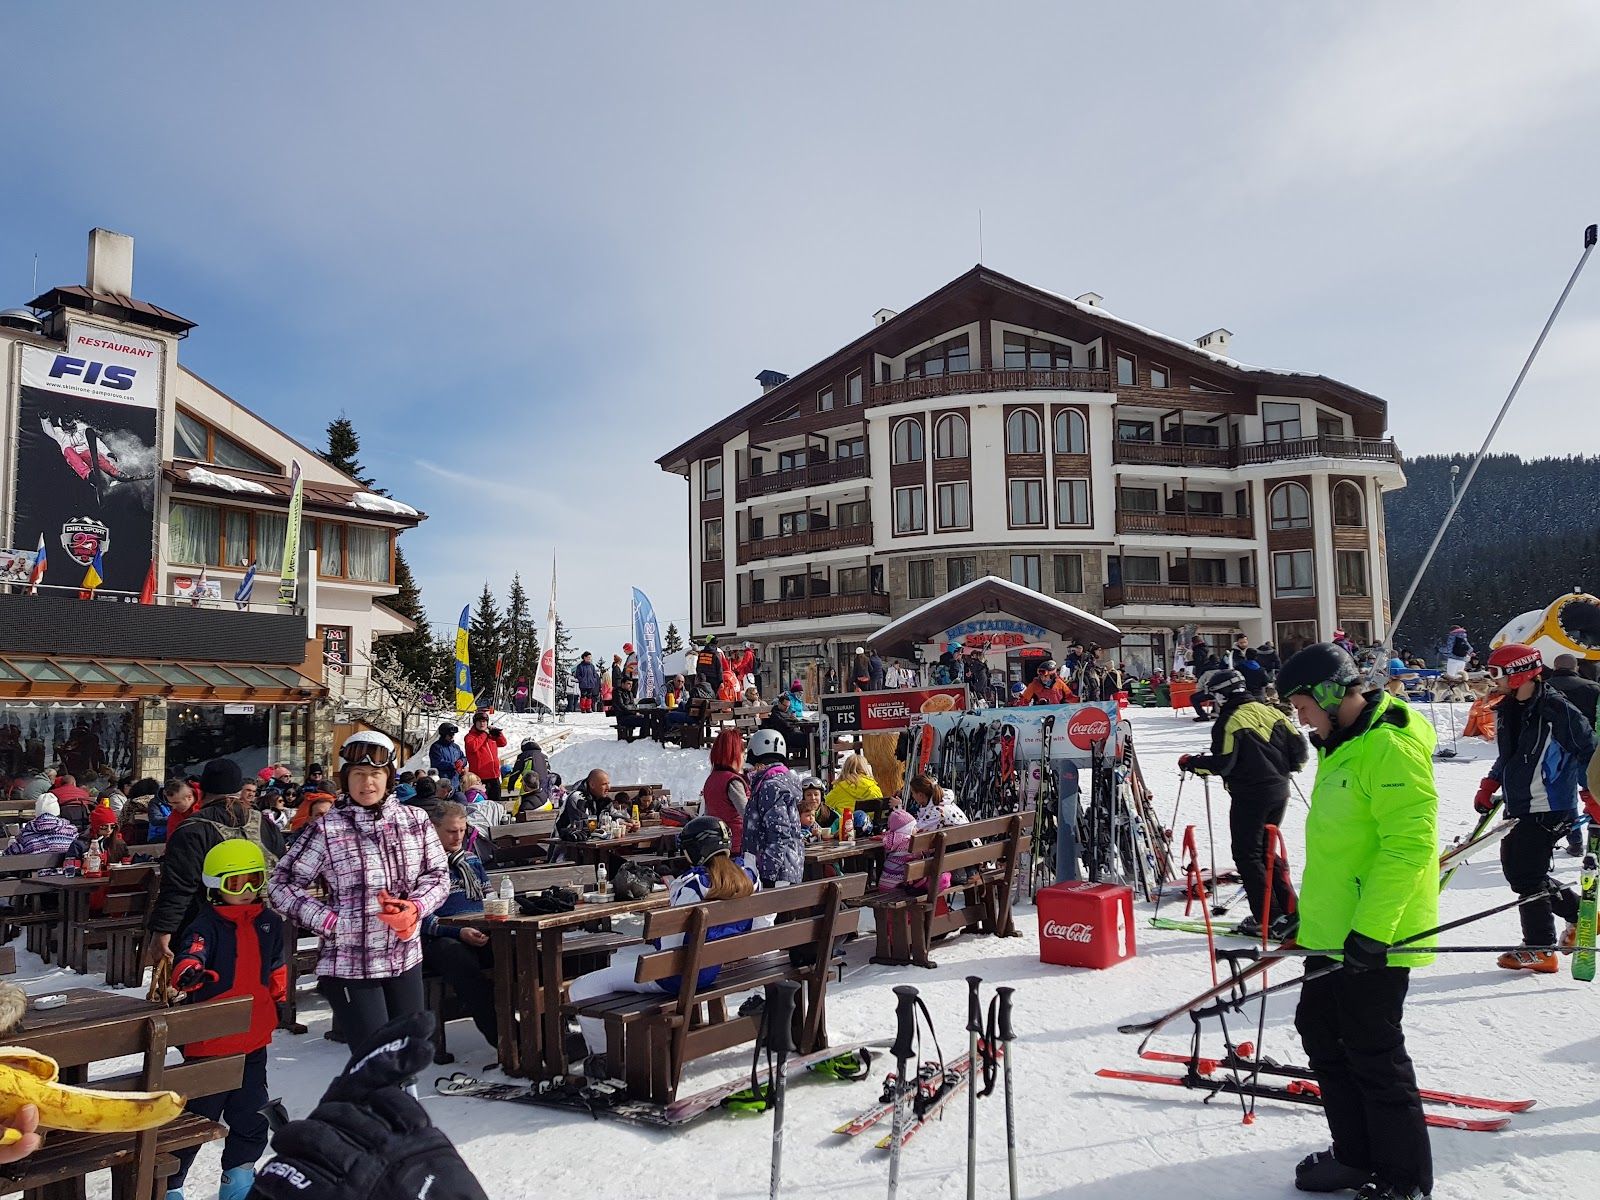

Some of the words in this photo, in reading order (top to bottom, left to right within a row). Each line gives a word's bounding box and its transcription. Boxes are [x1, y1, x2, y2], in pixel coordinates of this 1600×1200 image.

[77, 336, 154, 358] RESTAURANT
[48, 354, 137, 391] FIS
[826, 704, 855, 712] RESTAURANT
[837, 711, 856, 724] FIS
[1069, 721, 1109, 735] Coca-Cola
[1043, 920, 1095, 943] Coca-Cola
